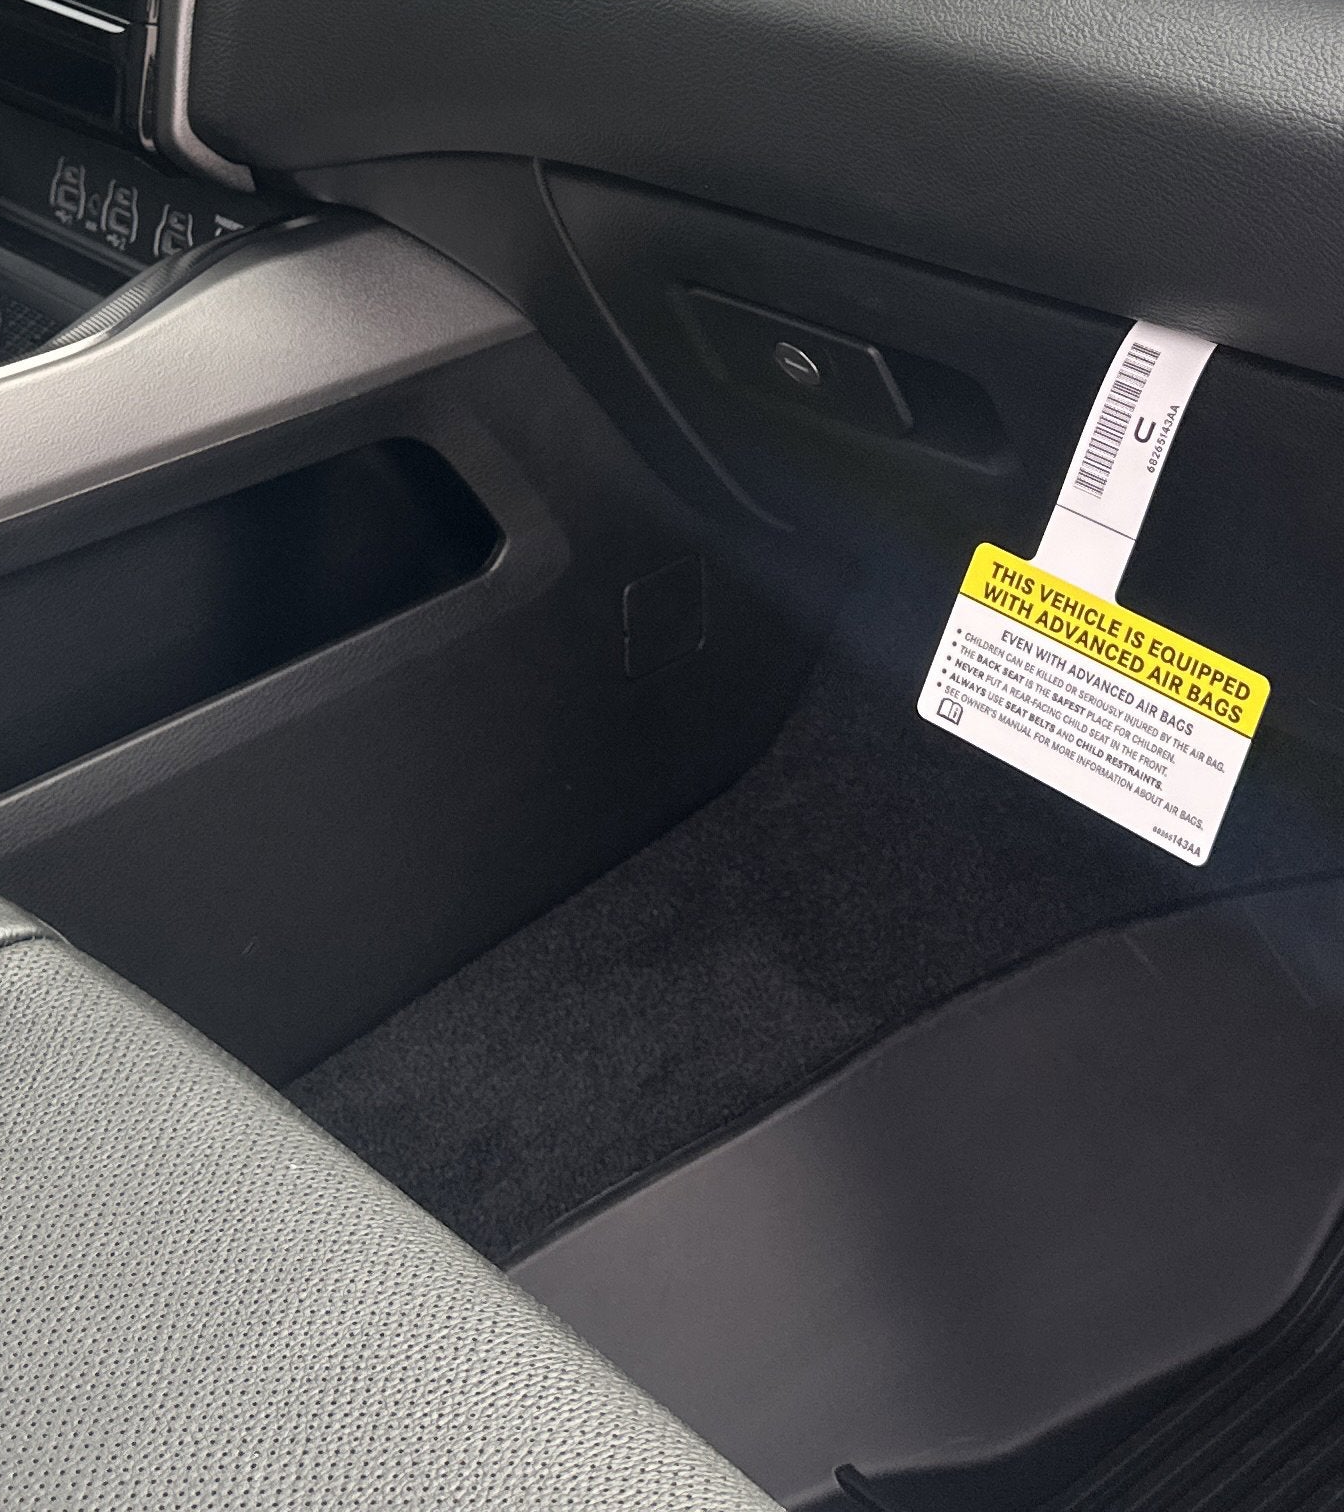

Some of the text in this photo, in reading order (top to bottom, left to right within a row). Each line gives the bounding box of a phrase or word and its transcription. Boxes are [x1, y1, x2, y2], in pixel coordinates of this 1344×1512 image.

[1134, 416, 1156, 443] U
[1146, 405, 1181, 474] 68265143AA
[980, 581, 1244, 725] WITH ADVANCED AIR BAGS
[988, 561, 1253, 703] THIS VEHICLE IS EQUIPPED
[999, 629, 1195, 737] EVEN WITH ADVANCED AIR BAGS
[948, 671, 987, 698] ALWAYS
[986, 690, 1005, 707] USE
[1003, 700, 1028, 719] SEAT
[1027, 712, 1056, 734] BELTS
[1055, 727, 1075, 744] AND
[1074, 737, 1105, 760] CHILD
[953, 657, 985, 681] NEVER
[1008, 686, 1062, 721] REAR-FACING
[1061, 714, 1089, 735] CHILD
[1087, 727, 1109, 746] SEAT
[1119, 744, 1138, 761] THE
[958, 644, 976, 660] THE
[975, 653, 1001, 673] BACK
[1000, 666, 1024, 685] SEAT
[1033, 683, 1051, 699] THE
[1050, 691, 1086, 717] SAFEST
[1085, 709, 1113, 731] PLACE
[1112, 724, 1132, 741] FOR
[963, 631, 1005, 659] CHILDREN
[1003, 652, 1023, 669] CAN
[1034, 667, 1065, 690] KILLED
[1077, 689, 1124, 720] SERIOUSLY
[1122, 712, 1159, 739] INJURED
[1170, 737, 1190, 754] THE
[1188, 746, 1205, 762] AIR
[943, 684, 960, 700] SEE
[959, 692, 998, 720] OWNER'S
[996, 712, 1033, 739] MANUAL
[1032, 731, 1051, 748] FOR
[1049, 740, 1076, 762] MORE
[1074, 753, 1133, 792] INFORMATION
[1132, 784, 1163, 808] ABOUT
[1162, 800, 1180, 817] AIR
